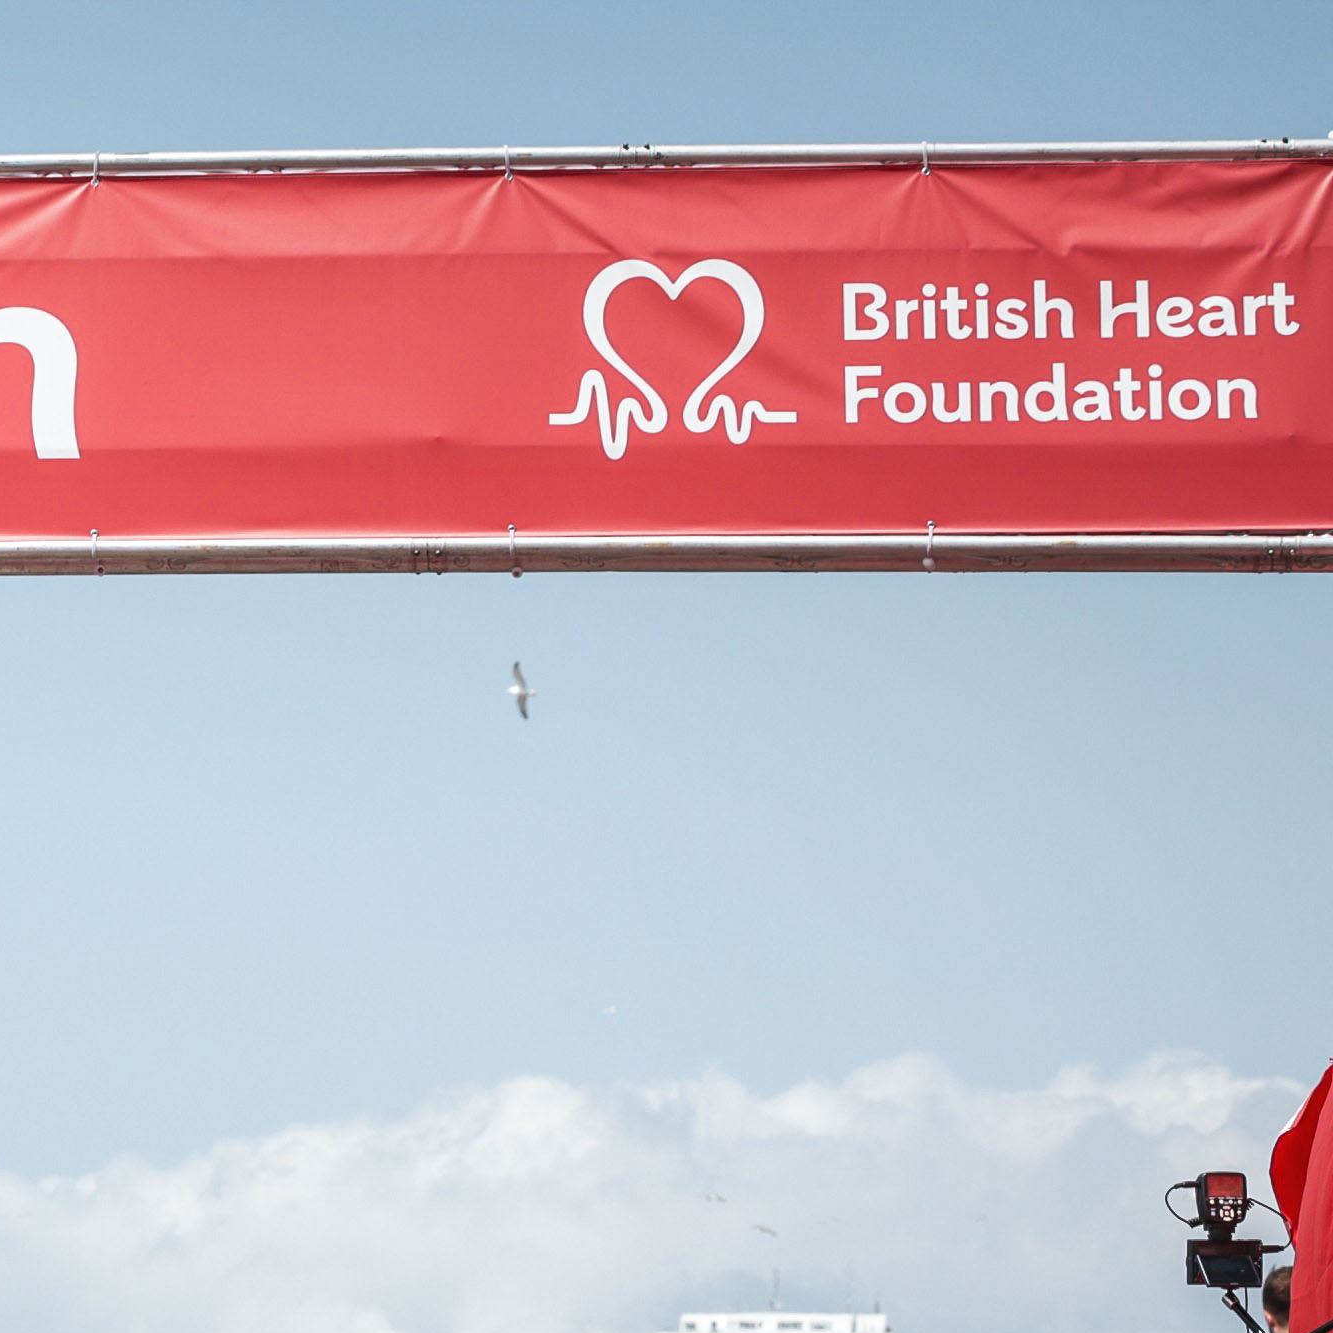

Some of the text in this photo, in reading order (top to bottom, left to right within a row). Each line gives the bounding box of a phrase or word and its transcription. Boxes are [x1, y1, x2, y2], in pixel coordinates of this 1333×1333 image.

[842, 279, 1300, 341] British Heart
[843, 362, 1259, 425] Foundation
